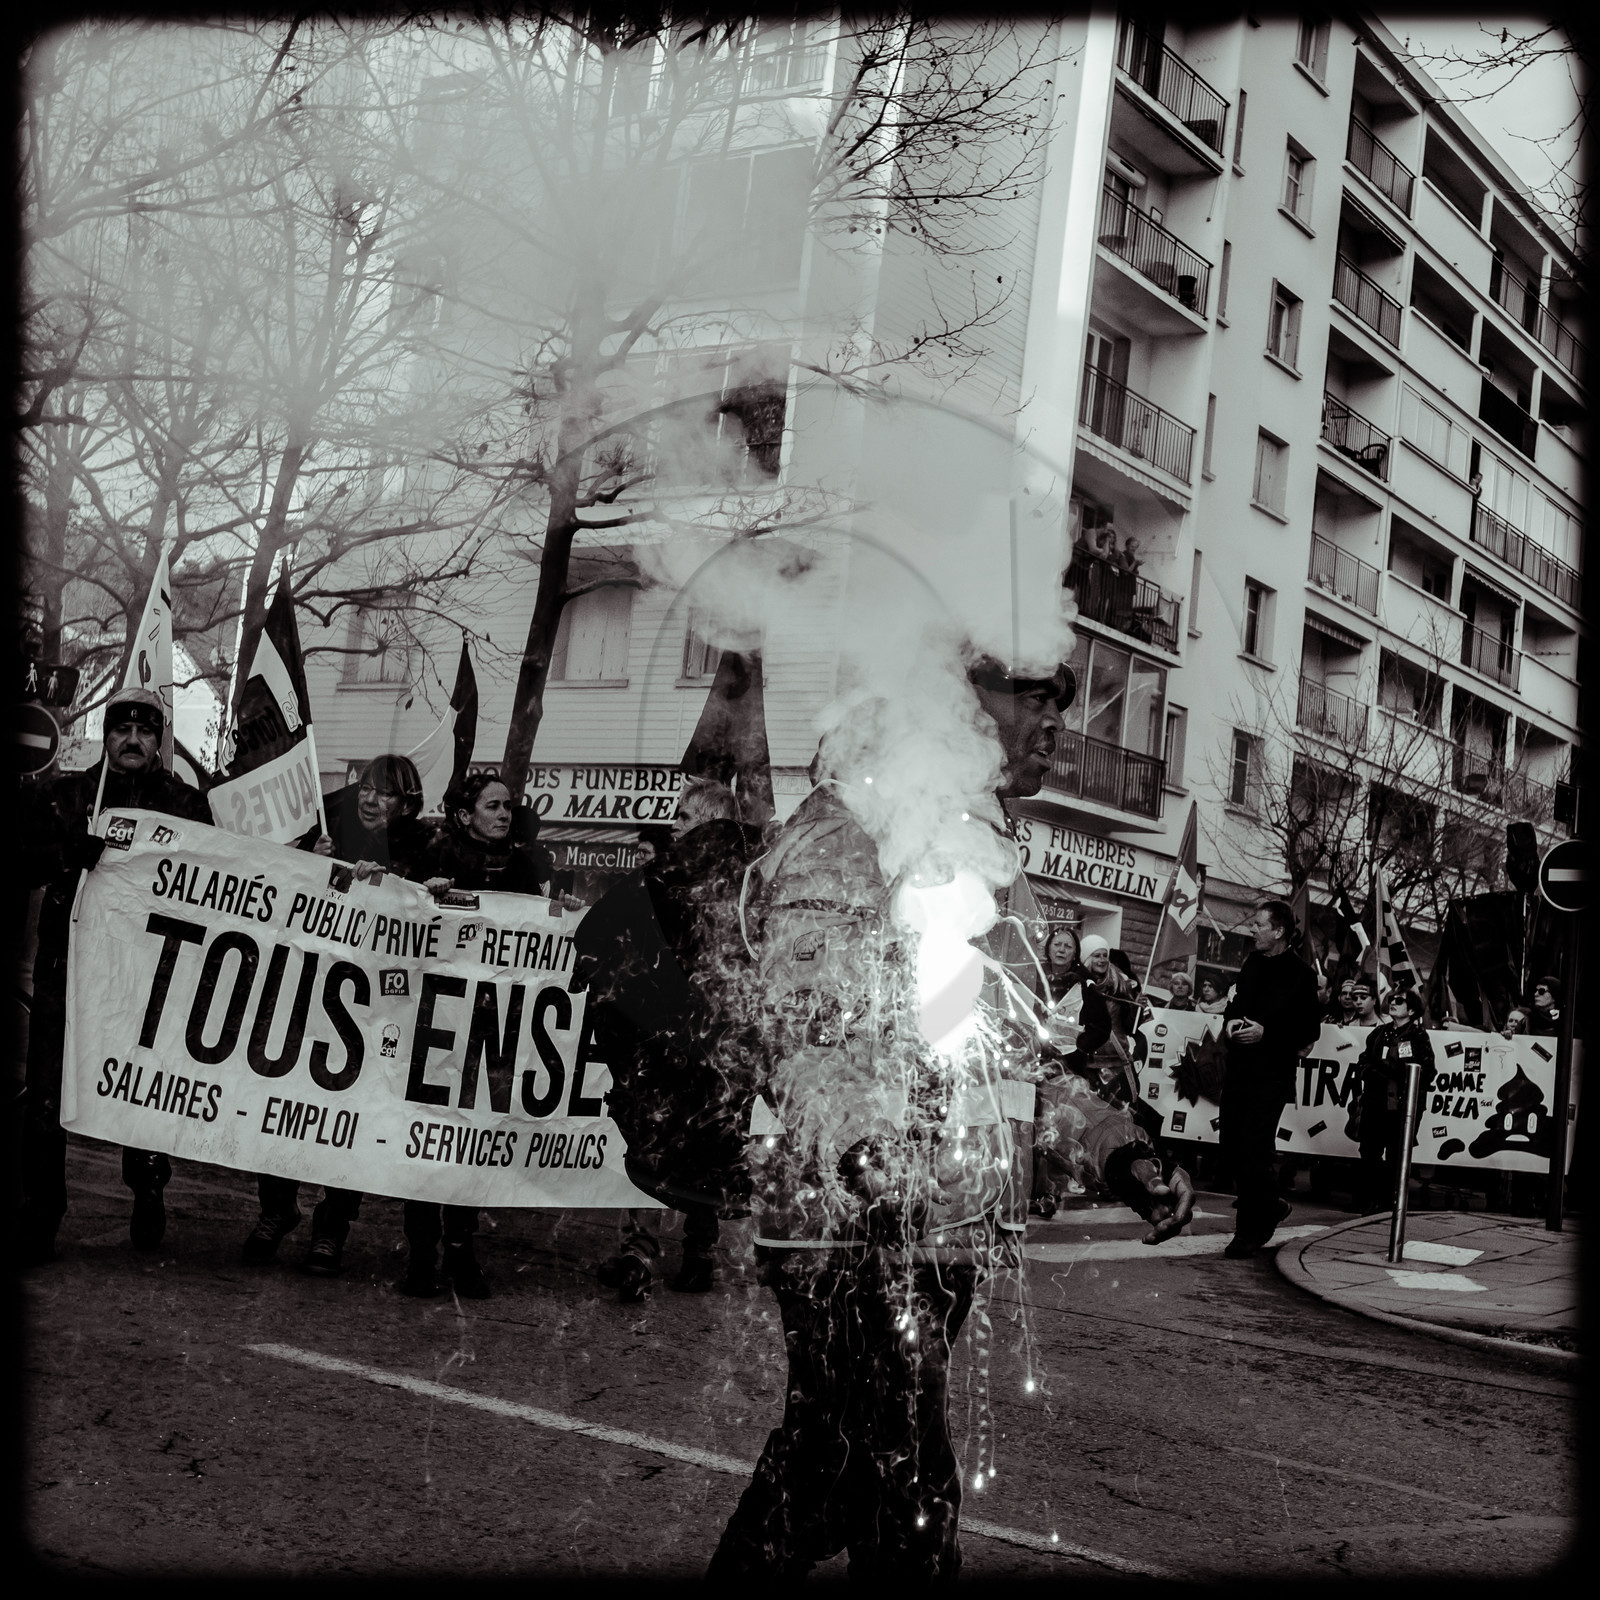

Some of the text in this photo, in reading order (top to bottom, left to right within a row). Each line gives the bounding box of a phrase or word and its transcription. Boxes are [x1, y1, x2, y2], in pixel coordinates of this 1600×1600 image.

[571, 769, 688, 792] FUNEBRE
[107, 826, 134, 841] cgt
[1050, 827, 1137, 868] FUNEBRES
[1041, 851, 1158, 900] MARCELLIN
[151, 858, 278, 921] SALARIÉS
[286, 893, 442, 959] PUBLIC/PRIVÉ
[138, 912, 371, 1091] TOUS
[385, 973, 405, 989] FO
[97, 1057, 222, 1122] SALAIRES
[260, 1097, 360, 1150] EMPLOI
[405, 1121, 518, 1168] SERVICES
[525, 1132, 607, 1169] PUBLICS
